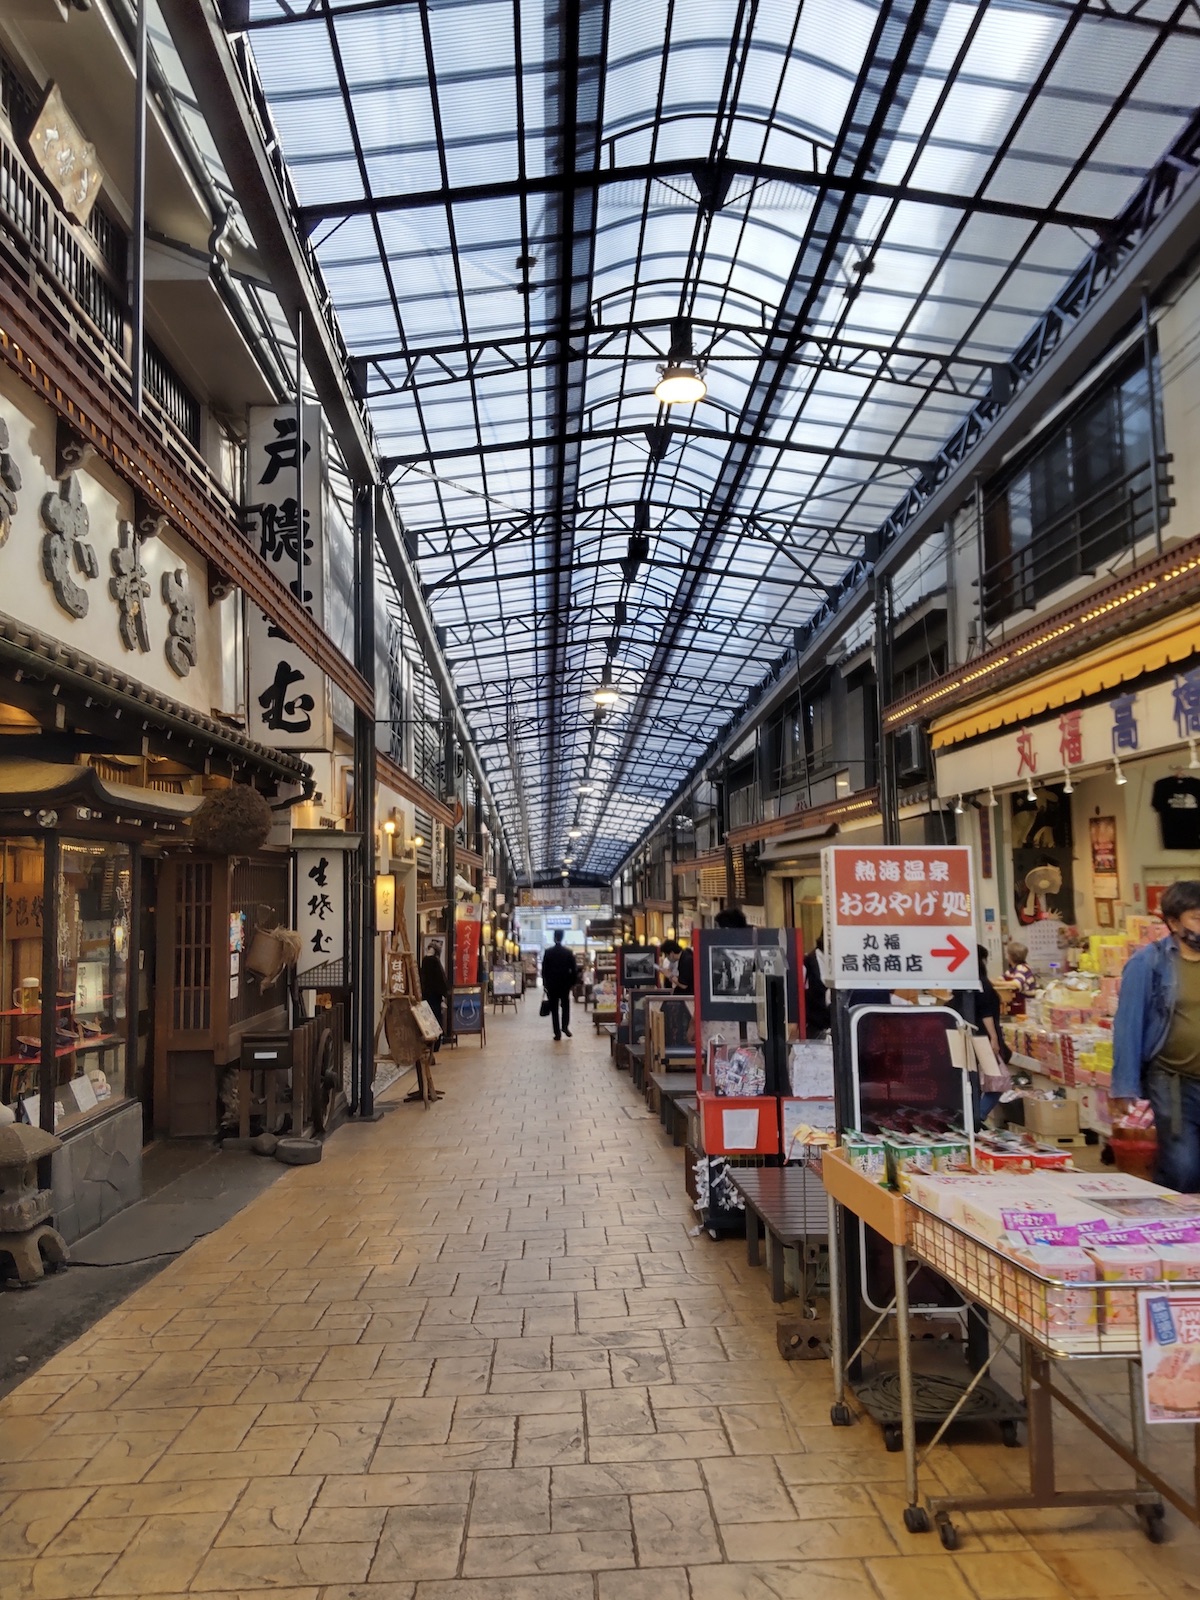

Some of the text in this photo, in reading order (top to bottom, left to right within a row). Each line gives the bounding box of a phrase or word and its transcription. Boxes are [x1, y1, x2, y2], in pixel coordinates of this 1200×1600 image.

[855, 860, 950, 882] 熱海温泉
[839, 890, 969, 917] おみやげ処
[863, 933, 901, 951] 丸福
[841, 954, 923, 973] 高橋商店
[391, 960, 405, 994] 甘味処
